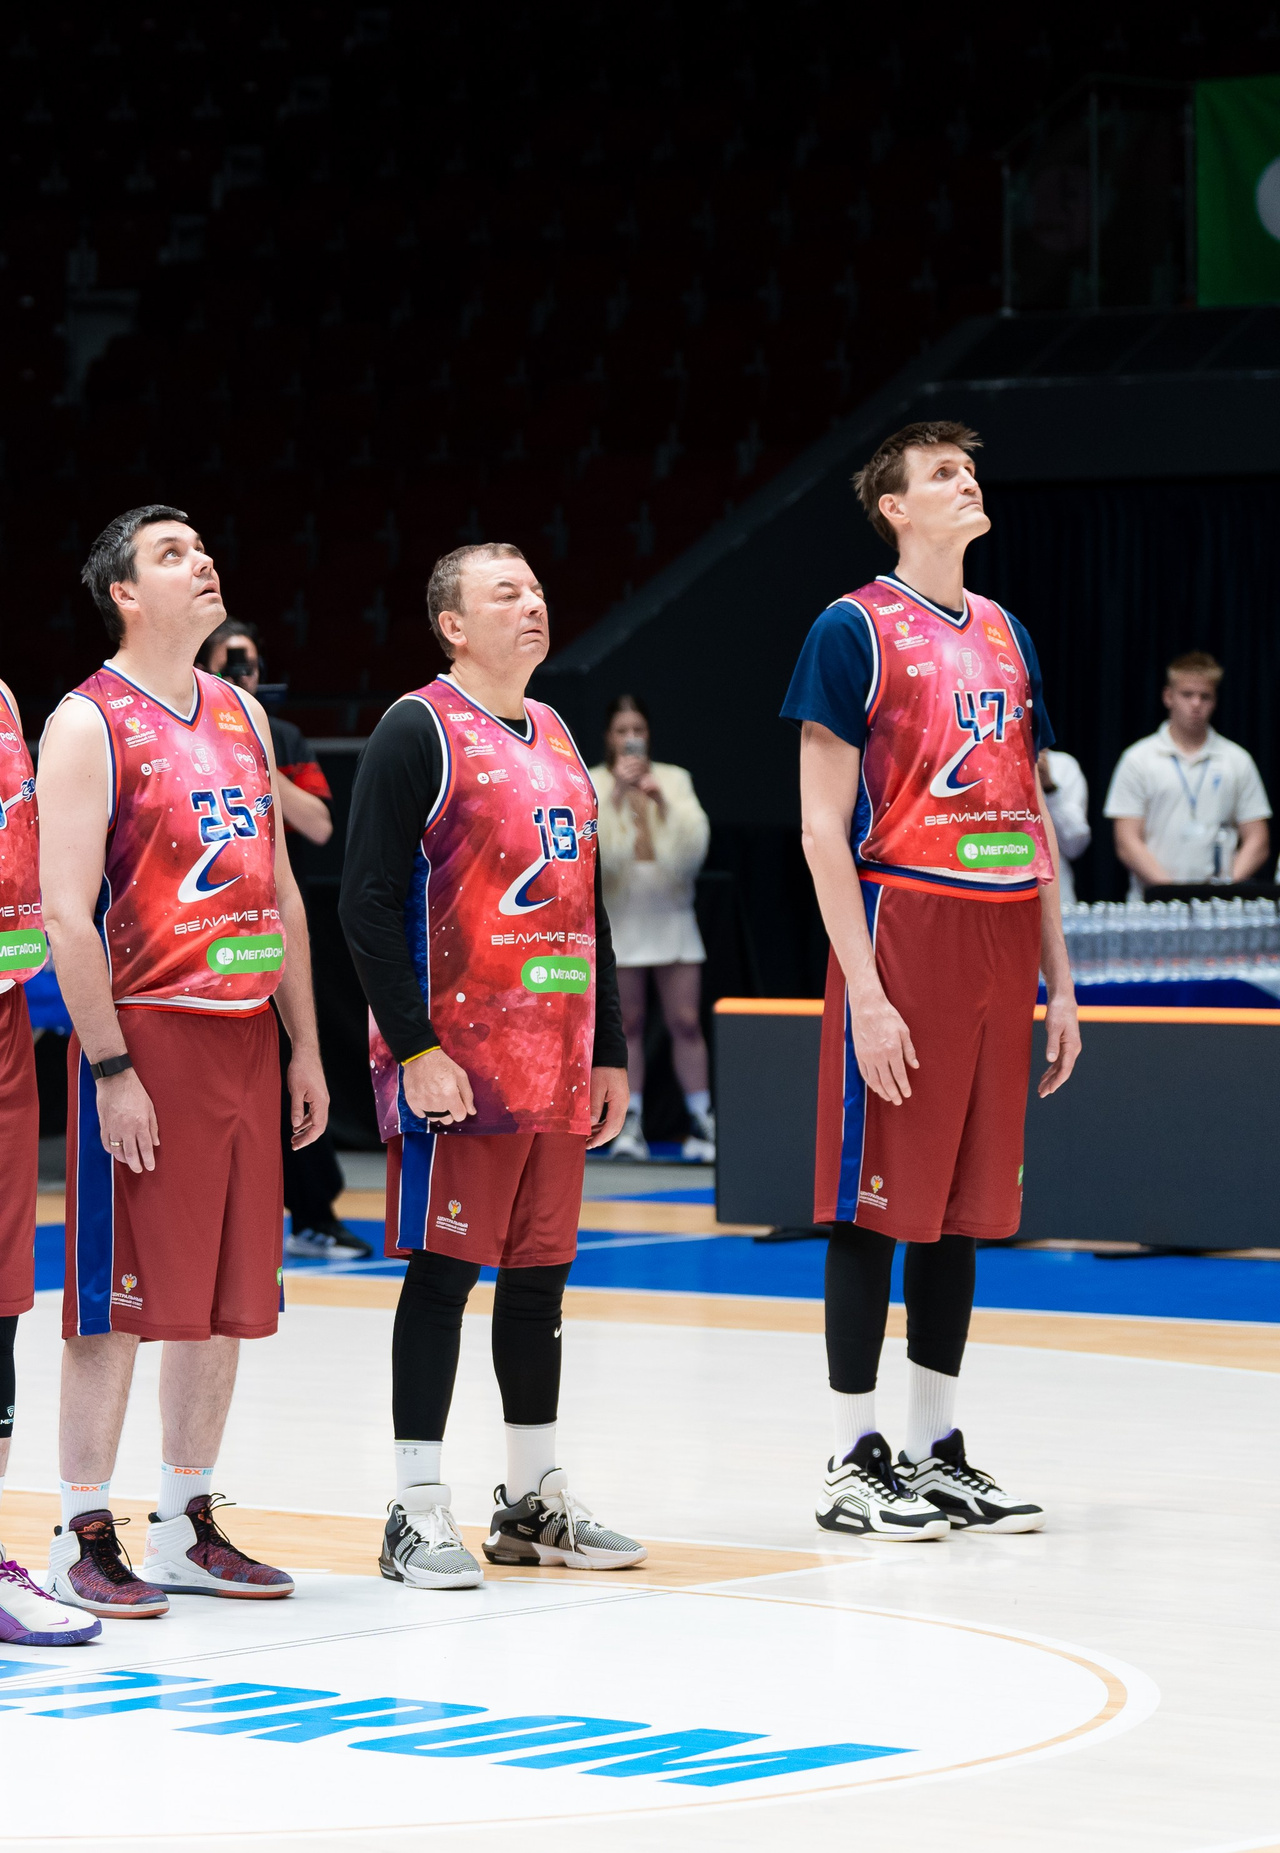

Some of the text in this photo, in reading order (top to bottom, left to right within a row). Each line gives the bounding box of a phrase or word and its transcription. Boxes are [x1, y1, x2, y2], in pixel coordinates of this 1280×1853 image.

[876, 603, 905, 615] ZEDO
[107, 695, 134, 710] ZEDO
[447, 712, 474, 722] ZEDO
[952, 689, 1007, 744] 47
[190, 785, 259, 846] 25
[924, 811, 997, 826] ВЕЛИЧИЕ
[532, 806, 579, 862] 18
[174, 910, 258, 935] ВЕЛИЧИЕ
[491, 932, 565, 945] ВЕЛИЧИЕ
[174, 1468, 202, 1476] DDX
